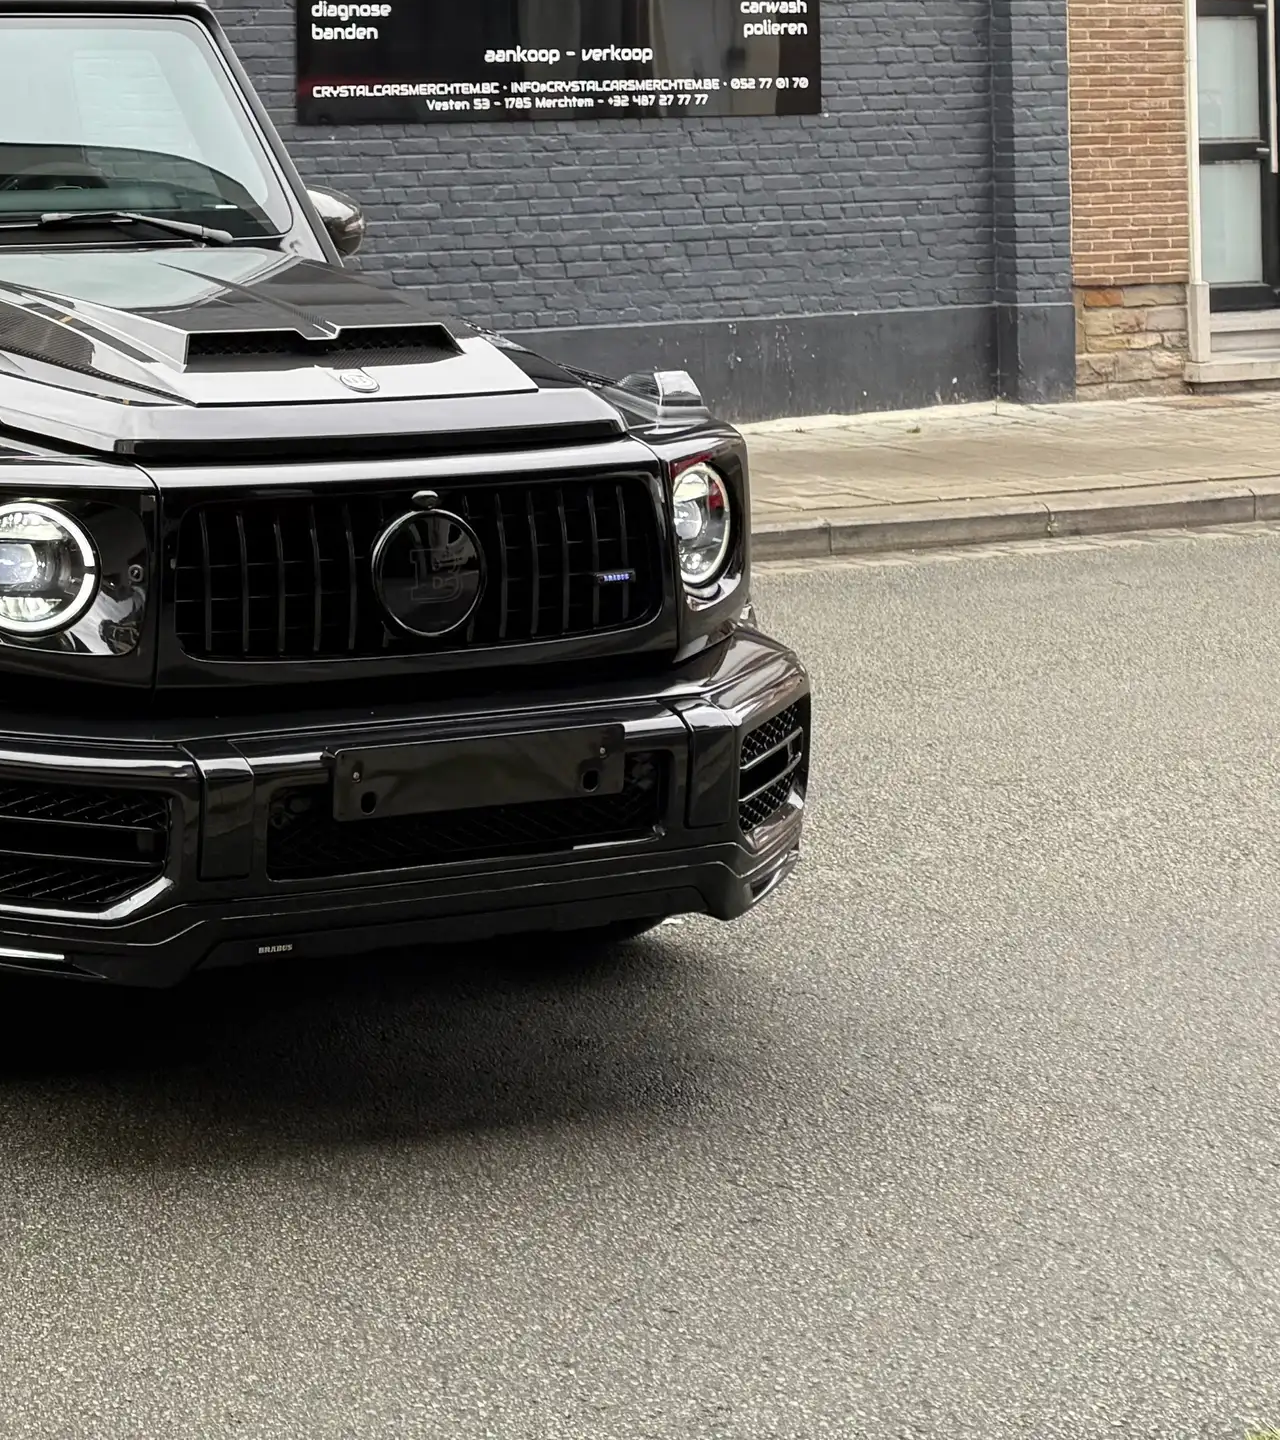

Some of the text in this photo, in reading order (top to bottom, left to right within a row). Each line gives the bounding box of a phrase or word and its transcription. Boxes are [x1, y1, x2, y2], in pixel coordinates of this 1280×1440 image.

[312, 1, 391, 20] diagnose
[312, 23, 378, 39] banden
[744, 19, 807, 38] polieren
[485, 46, 560, 64] aankoop
[582, 45, 653, 63] verkoop
[731, 78, 755, 89] 052
[759, 78, 772, 88] 77
[776, 78, 789, 88] 01
[792, 77, 808, 88] 70
[427, 100, 469, 110] Vesten
[474, 98, 490, 109] 53
[505, 97, 531, 108] 1785
[535, 96, 593, 108] Merchtem
[608, 95, 629, 106] +32
[633, 95, 655, 106] 487
[659, 95, 674, 105] 27
[677, 94, 691, 105] 77
[694, 94, 708, 104] 77
[258, 943, 293, 954] BRABUS
